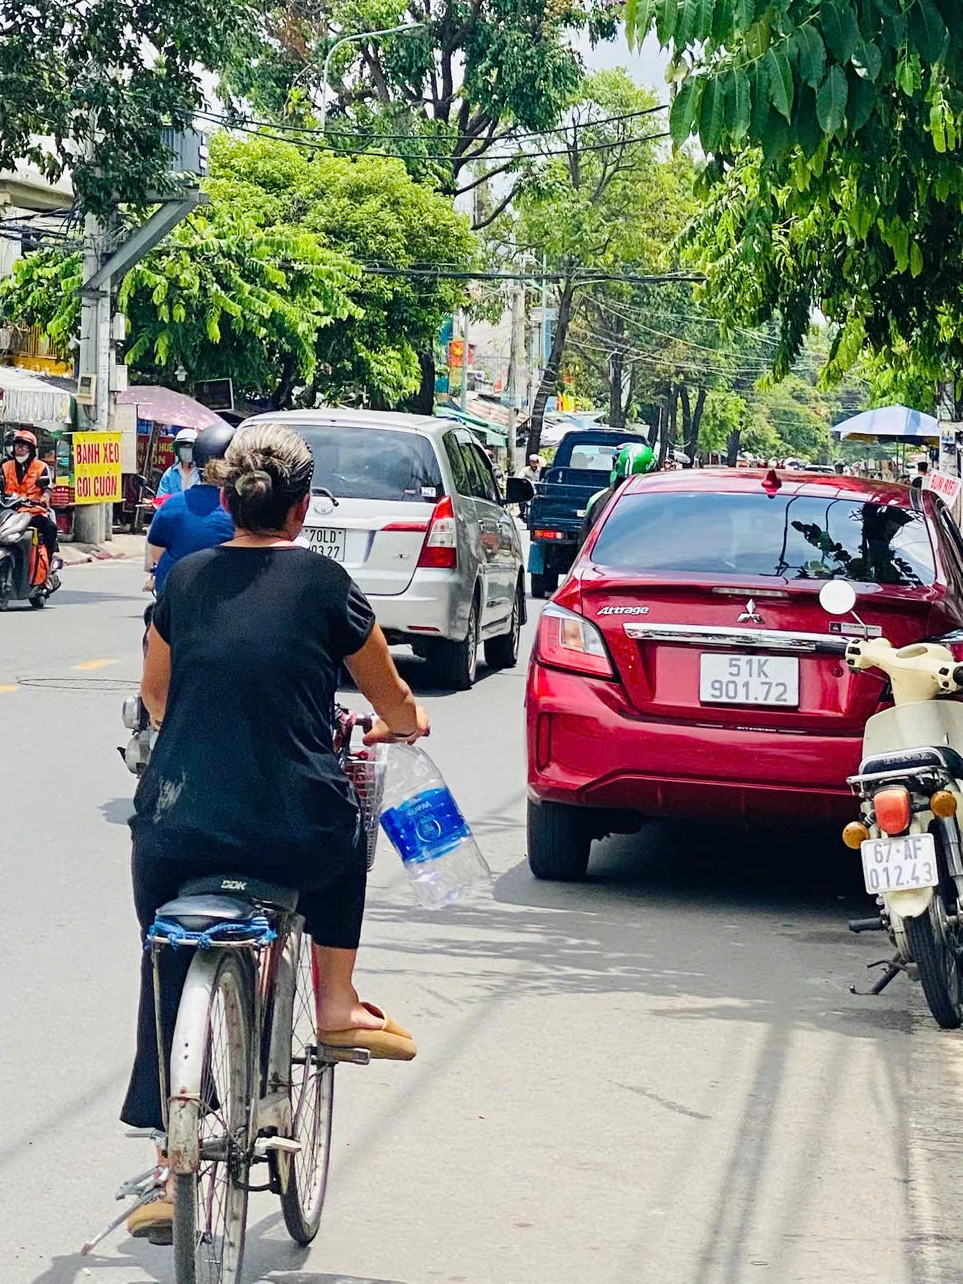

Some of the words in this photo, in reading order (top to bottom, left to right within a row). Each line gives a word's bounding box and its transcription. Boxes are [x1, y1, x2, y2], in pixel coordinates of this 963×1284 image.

[310, 529, 336, 543] 70LD
[597, 605, 650, 616] Attrage
[728, 657, 770, 679] 51K
[710, 679, 788, 703] 901.72
[873, 838, 924, 864] 67-AF
[869, 861, 934, 890] 012.43
